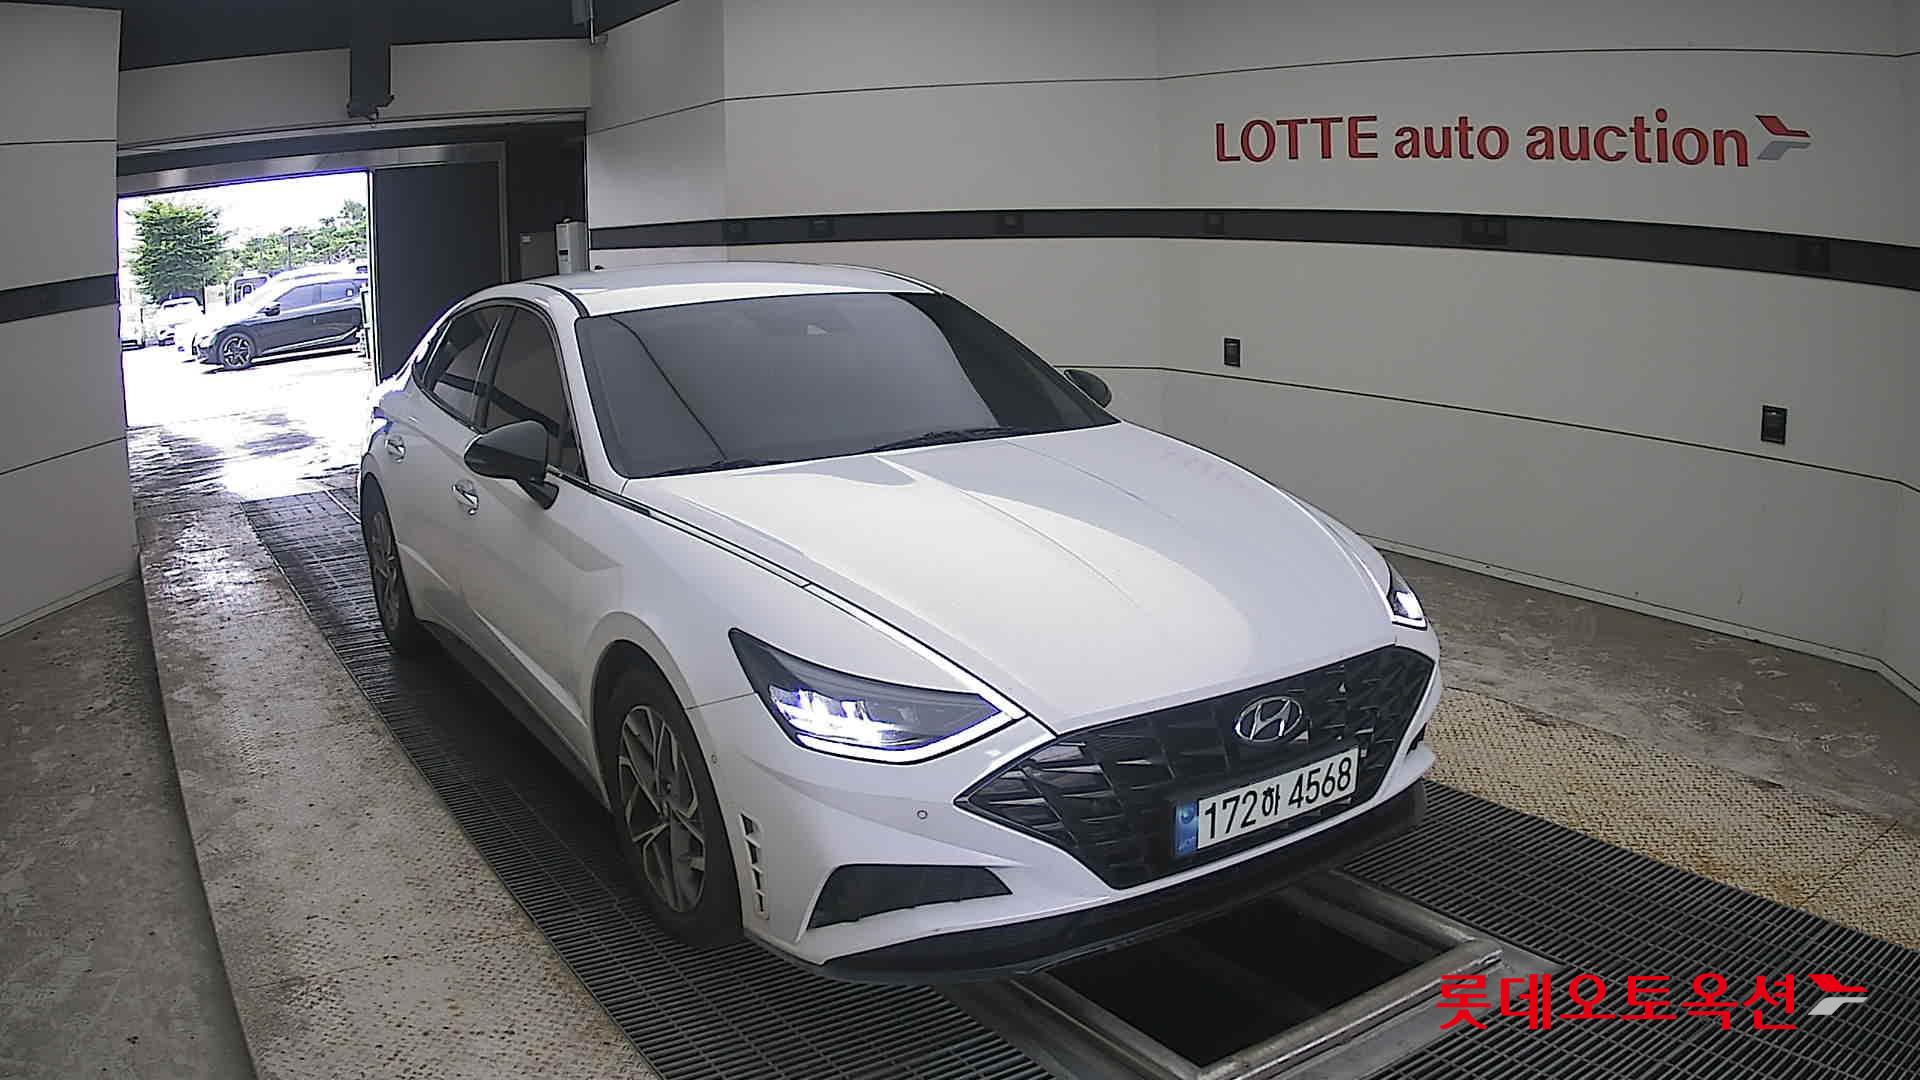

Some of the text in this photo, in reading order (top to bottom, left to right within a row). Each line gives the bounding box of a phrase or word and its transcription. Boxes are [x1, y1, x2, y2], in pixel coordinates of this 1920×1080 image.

[1215, 107, 1749, 167] LOTTE auto auction
[1204, 757, 1351, 839] 172하 4568
